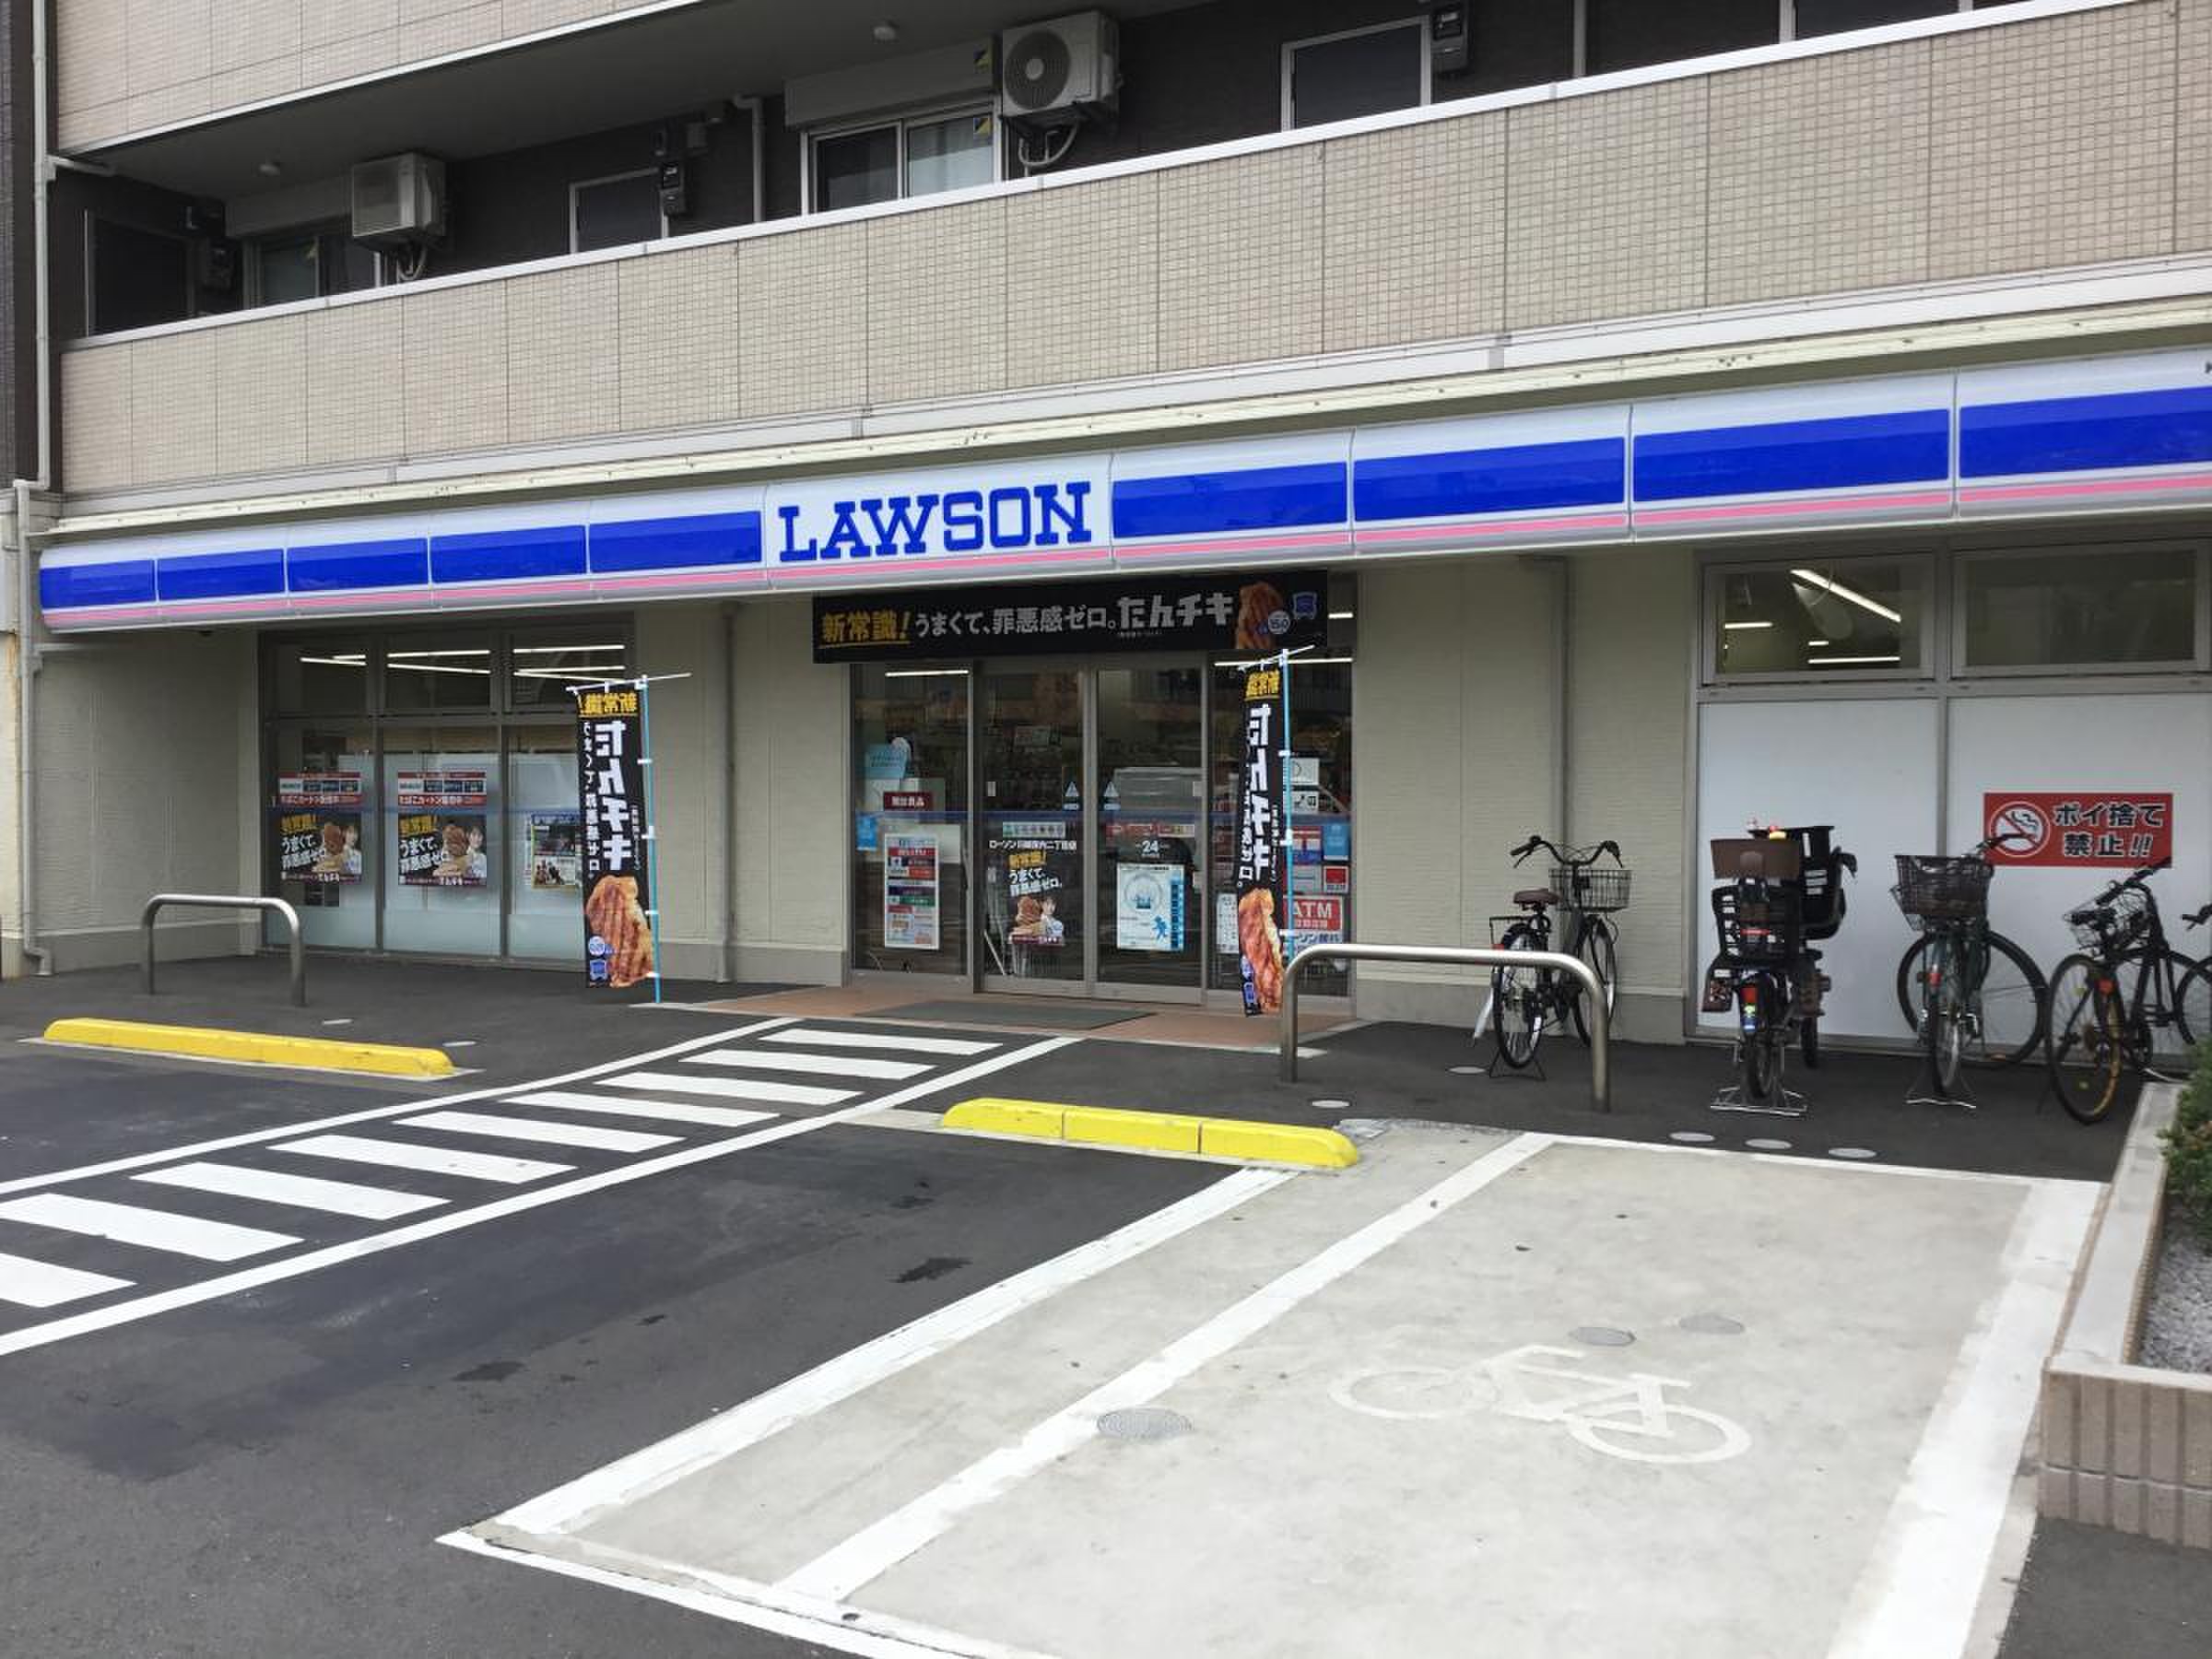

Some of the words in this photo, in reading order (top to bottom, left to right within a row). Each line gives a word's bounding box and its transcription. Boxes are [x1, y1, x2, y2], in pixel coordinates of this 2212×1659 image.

[779, 481, 1092, 562] LAWSON
[1117, 592, 1234, 629] たんチキ
[2053, 802, 2166, 828] ポイ捨て
[1142, 840, 1159, 853] 24
[2063, 831, 2153, 857] 禁止!!
[1291, 900, 1332, 918] ATM
